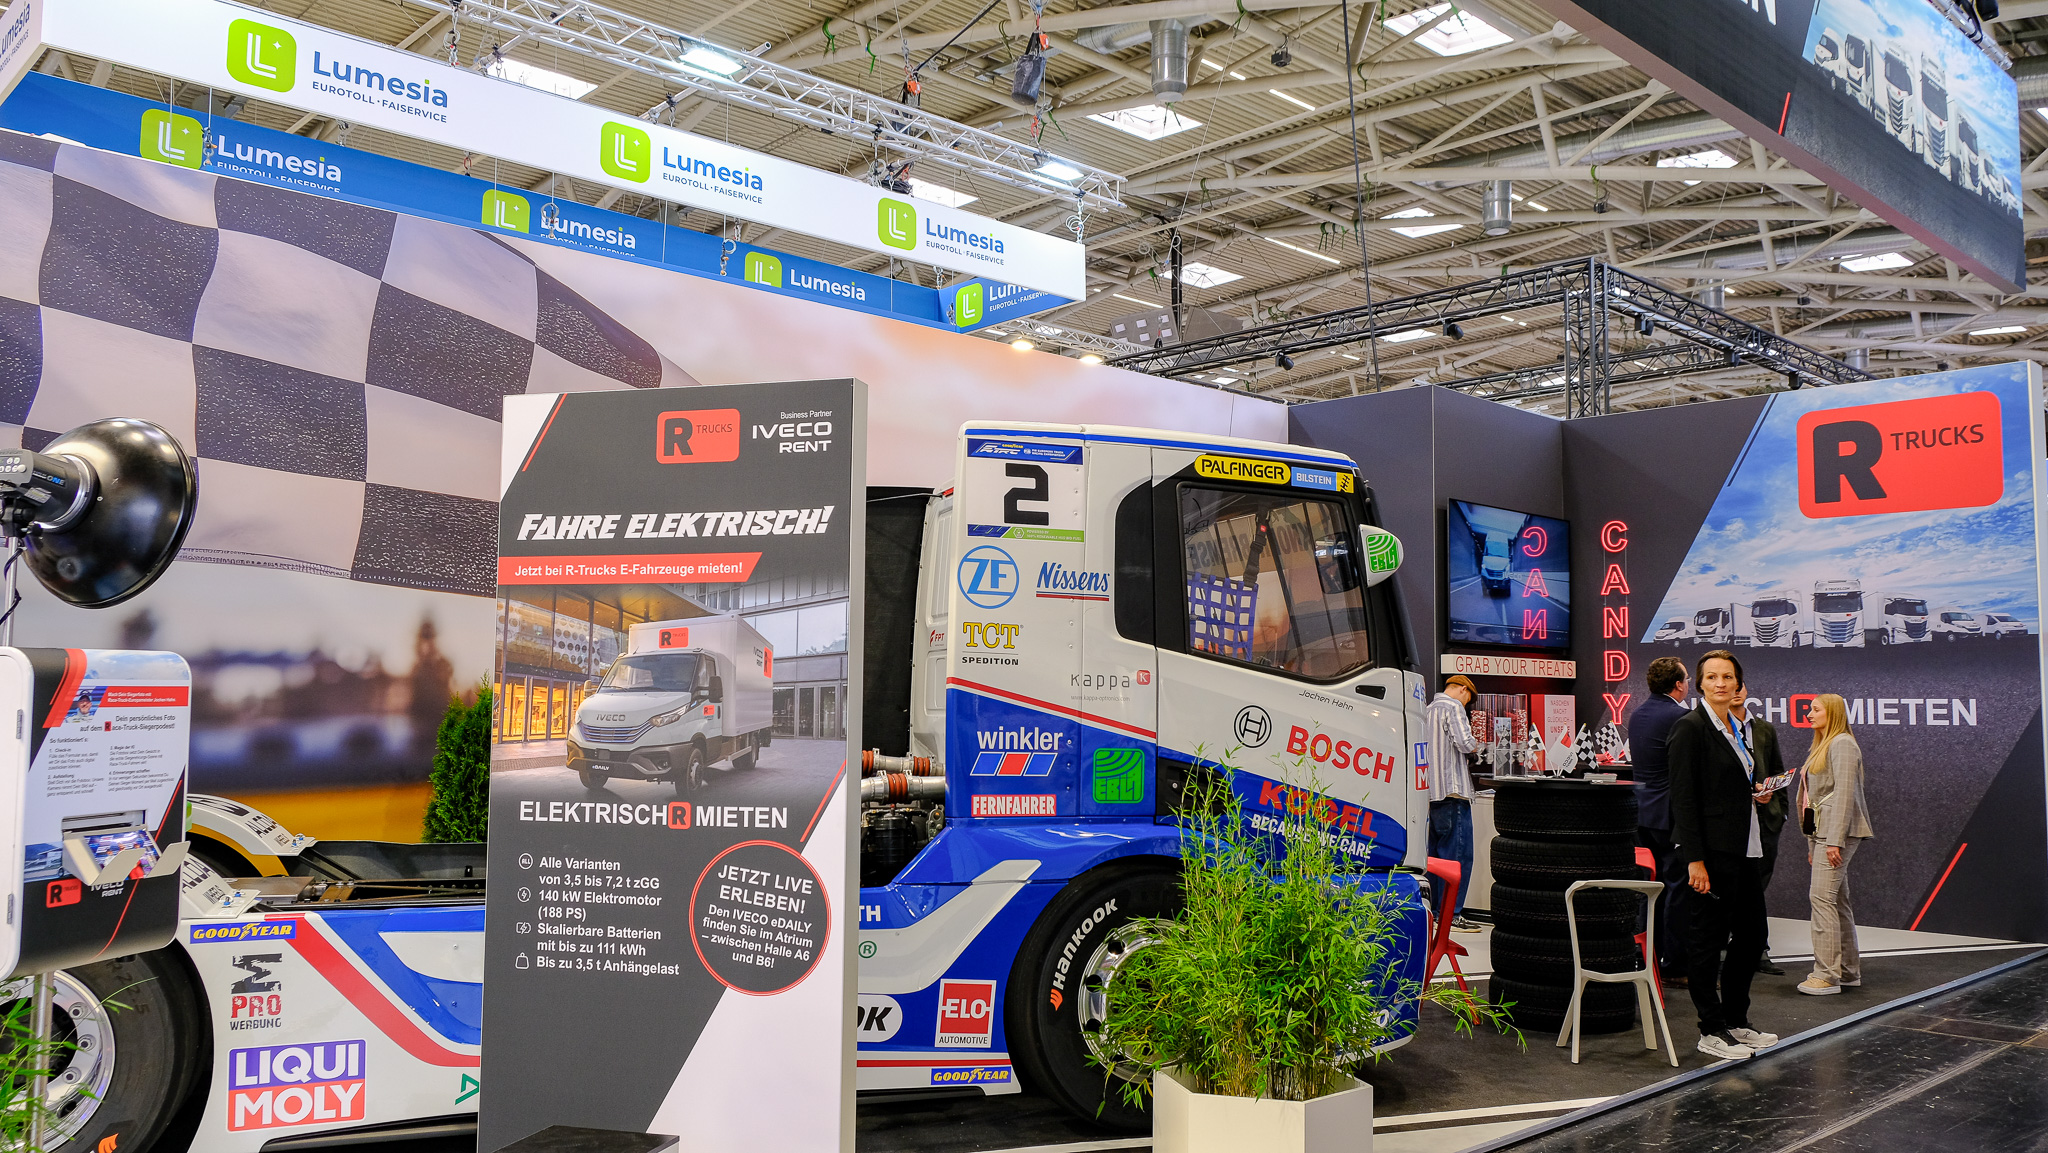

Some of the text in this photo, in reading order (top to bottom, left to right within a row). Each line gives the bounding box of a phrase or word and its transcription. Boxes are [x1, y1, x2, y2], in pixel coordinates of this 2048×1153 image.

[0, 2, 30, 57] umesia
[313, 50, 448, 108] Lumesia
[217, 134, 341, 182] Lumesia
[663, 146, 763, 191] Lumesia
[540, 211, 636, 249] Lumesia
[926, 217, 1004, 254] Lumesia
[790, 269, 866, 302] Lumesia
[780, 409, 833, 420] Business Partner
[663, 417, 733, 456] R TRUCKS
[752, 421, 833, 439] IVECO
[779, 440, 832, 453] RENT
[1201, 458, 1285, 481] PALFINGER
[1813, 420, 1984, 504] R TRUCKS
[1296, 472, 1332, 485] BILSTEIN
[1004, 463, 1049, 526] 2
[517, 505, 835, 541] FAHRE ELEKTRISCH!
[515, 562, 743, 577] Jetzt bei R-Trucks E-Fahrzeuge mieten!
[963, 557, 1014, 596] ZF
[1037, 561, 1110, 592] Nissens
[1601, 520, 1631, 725] CANDY
[935, 632, 945, 642] FPT
[963, 621, 1019, 649] TCT
[961, 656, 1019, 666] SPEDITION
[1456, 656, 1574, 678] GRAB YOUR TREATS
[1299, 689, 1354, 711] Jochen Hahn
[1842, 698, 1978, 726] MIETEN
[596, 713, 626, 722] IVECO
[1550, 725, 1570, 734] UNSEE
[977, 726, 1063, 750] winkler
[1286, 725, 1395, 784] BOSCH
[519, 800, 667, 827] ELEKTRISCH
[696, 806, 788, 829] MIETEN
[972, 795, 1055, 815] FERNFAHRER
[1340, 838, 1372, 859] CARE
[539, 857, 621, 871] Alle Varianten
[539, 875, 561, 885] von
[563, 874, 582, 887] 3,5
[584, 875, 602, 888] bis
[605, 875, 624, 889] 7,2
[633, 877, 660, 890] zGG
[717, 864, 813, 895] JETZT LIVE
[50, 885, 62, 904] R
[538, 890, 662, 907] 140 kW Elektromotor
[719, 885, 806, 914] ERLEBEN!
[538, 906, 587, 921] (188 PS)
[708, 904, 812, 934] Den IVECO eDAILY
[537, 922, 661, 941] Skalierbare Batterien
[702, 917, 813, 948] finden Sie im Atrium
[537, 940, 646, 957] mit bis zu 111 kWh
[710, 935, 761, 954] zwischen
[764, 942, 791, 959] Halle
[794, 948, 810, 962] A6
[732, 950, 775, 969] und B6!
[537, 956, 555, 968] Bis
[558, 959, 572, 969] zu
[575, 958, 593, 972] 3,5
[603, 960, 680, 977] Anhängelast
[231, 994, 282, 1020] PRO
[945, 998, 987, 1019] ELO
[230, 1018, 282, 1031] WERBUNG
[938, 1036, 988, 1045] AUTOMOTIVE
[235, 1043, 359, 1086] LIQUI
[234, 1083, 357, 1128] MOLY
